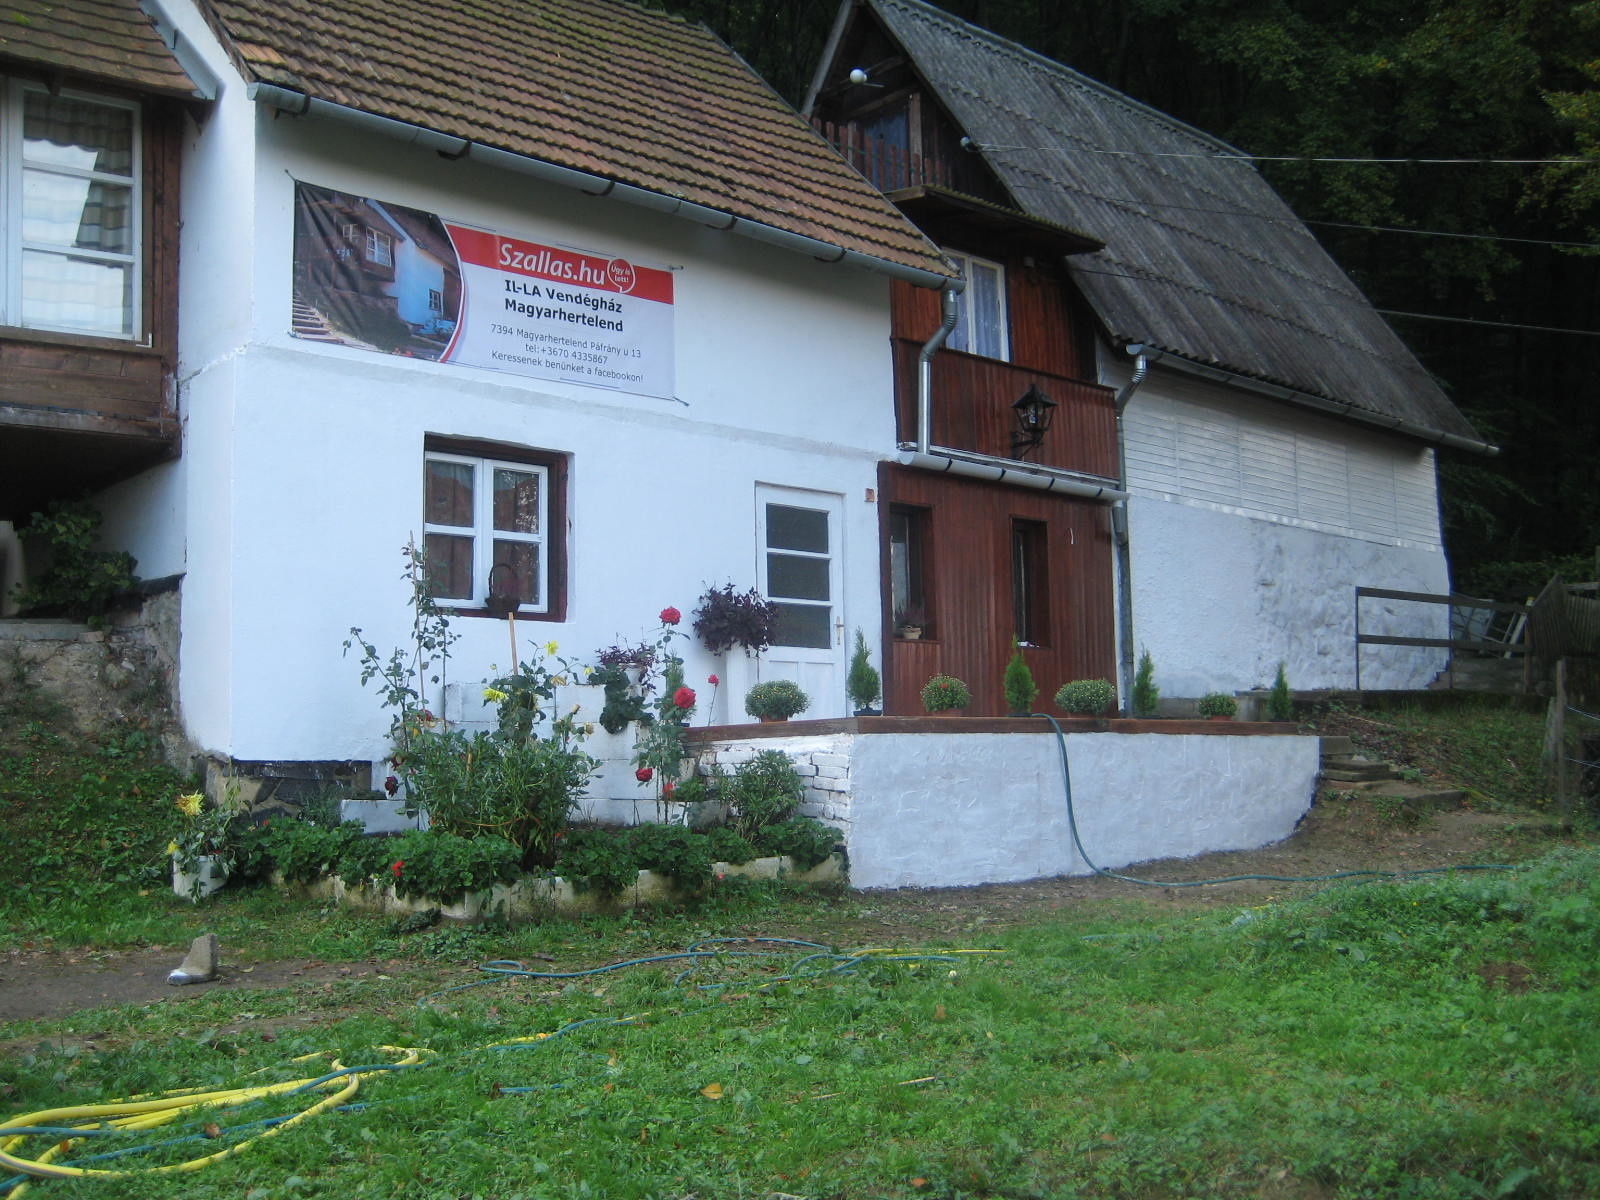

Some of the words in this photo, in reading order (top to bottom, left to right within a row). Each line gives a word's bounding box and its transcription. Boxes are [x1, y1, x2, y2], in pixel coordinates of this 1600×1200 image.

[499, 244, 605, 285] Szallas.hu
[505, 298, 624, 332] Magyarhertelend
[546, 287, 623, 314] Vendégház
[491, 323, 513, 335] 7394
[516, 328, 588, 349] Magyarhertelend
[591, 341, 621, 357] Páfrány
[632, 349, 641, 358] 13
[491, 350, 542, 367] Keressenek
[545, 359, 585, 374] benünket
[595, 366, 643, 383] facebookon!
[572, 351, 608, 364] 4335867
